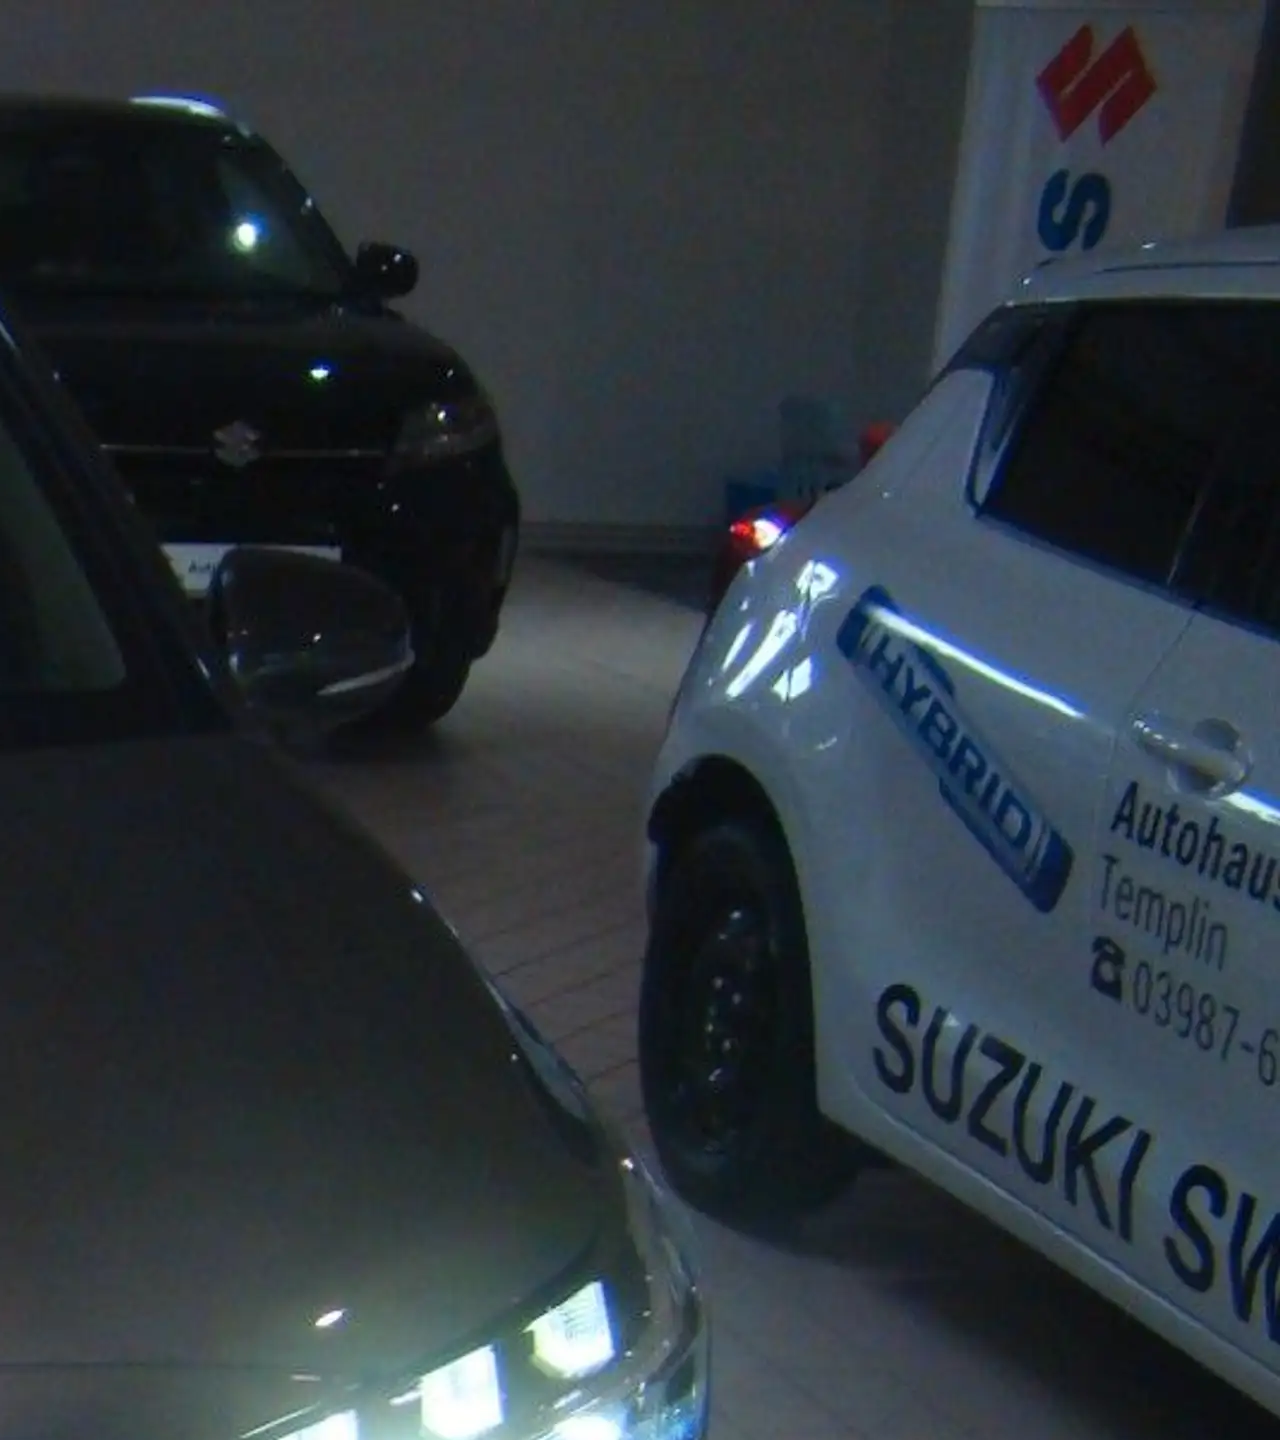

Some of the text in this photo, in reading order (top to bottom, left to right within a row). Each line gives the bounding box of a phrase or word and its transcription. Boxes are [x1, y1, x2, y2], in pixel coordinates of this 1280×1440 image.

[868, 632, 1033, 850] HYBRID
[1101, 854, 1228, 972] Templin
[873, 983, 1152, 1245] SUZUKI
